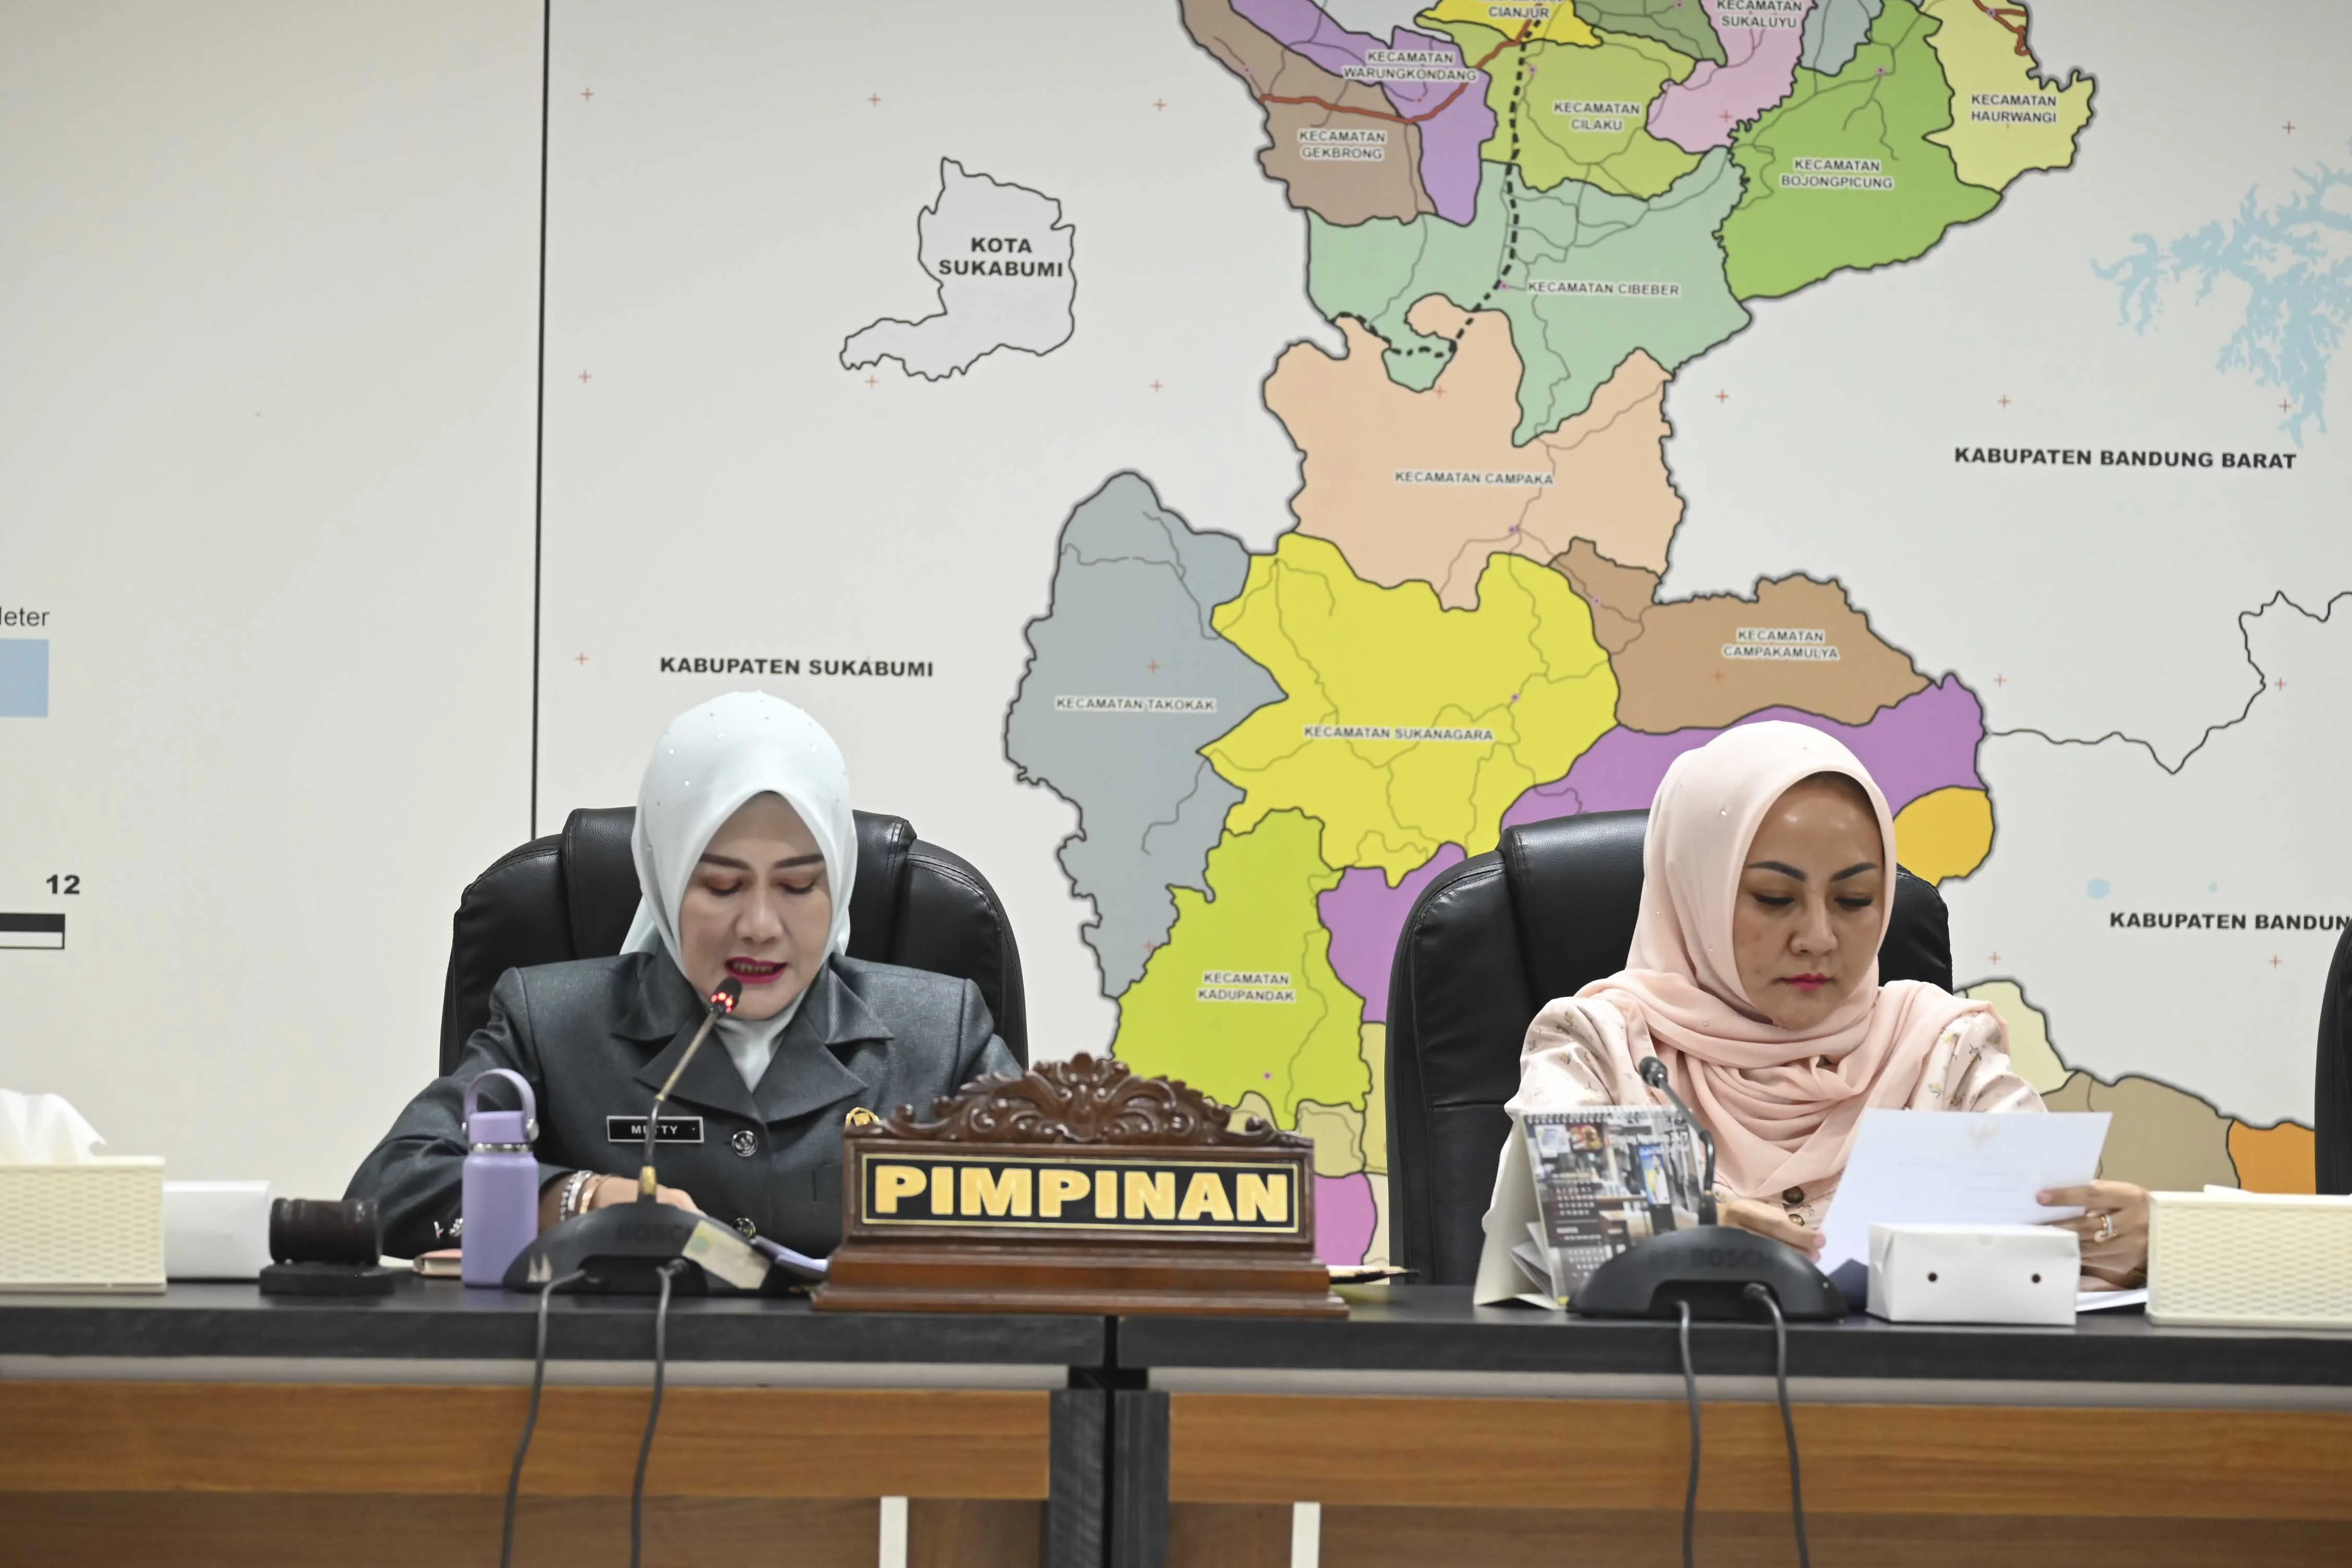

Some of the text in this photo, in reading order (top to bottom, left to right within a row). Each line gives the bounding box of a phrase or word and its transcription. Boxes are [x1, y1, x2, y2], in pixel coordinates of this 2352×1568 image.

[1488, 6, 1549, 18] CIANJUR
[1717, 0, 1802, 11] KECAMATAN
[1722, 15, 1796, 28] SUKALUYU
[1368, 51, 1454, 64] KECAMATAN
[1344, 67, 1477, 82] WARUNGKONDANG
[1971, 94, 2056, 106] KECAMATAN
[1554, 102, 1639, 114] KECAMATAN
[1971, 111, 2056, 123] HAURWANGI
[1571, 119, 1622, 131] CILAKU
[1300, 130, 1385, 143] KECAMATAN
[1302, 147, 1382, 160] GEKBRONG
[1795, 160, 1880, 172] KECAMATAN
[1781, 175, 1893, 188] BOJONGPICUNG
[971, 237, 1032, 253] KOTA
[939, 260, 1062, 277] SUKABUMI
[1528, 283, 1679, 295] KECAMATAN CIBEBER
[1955, 447, 2297, 469] KABUPATEN BANDUNG BARAT
[1395, 472, 1553, 484] KECAMATAN CAMPAKA
[0, 606, 50, 627] eter
[1738, 629, 1823, 642] KECAMATAN
[1723, 646, 1838, 660] CAMPAKAMULYA
[660, 657, 933, 677] KABUPATEN SUKABUMI
[1057, 698, 1214, 709] KECAMATAN TAKOKAK
[1305, 727, 1493, 740] KECAMATAN SUKANAGARA
[46, 874, 80, 895] 12
[2110, 912, 2352, 930] KABUPATEN BANDUN
[1204, 973, 1289, 985] KECAMATAN
[1198, 989, 1293, 1001] KADUPANDAK
[874, 1164, 1289, 1222] PIMPINAN
